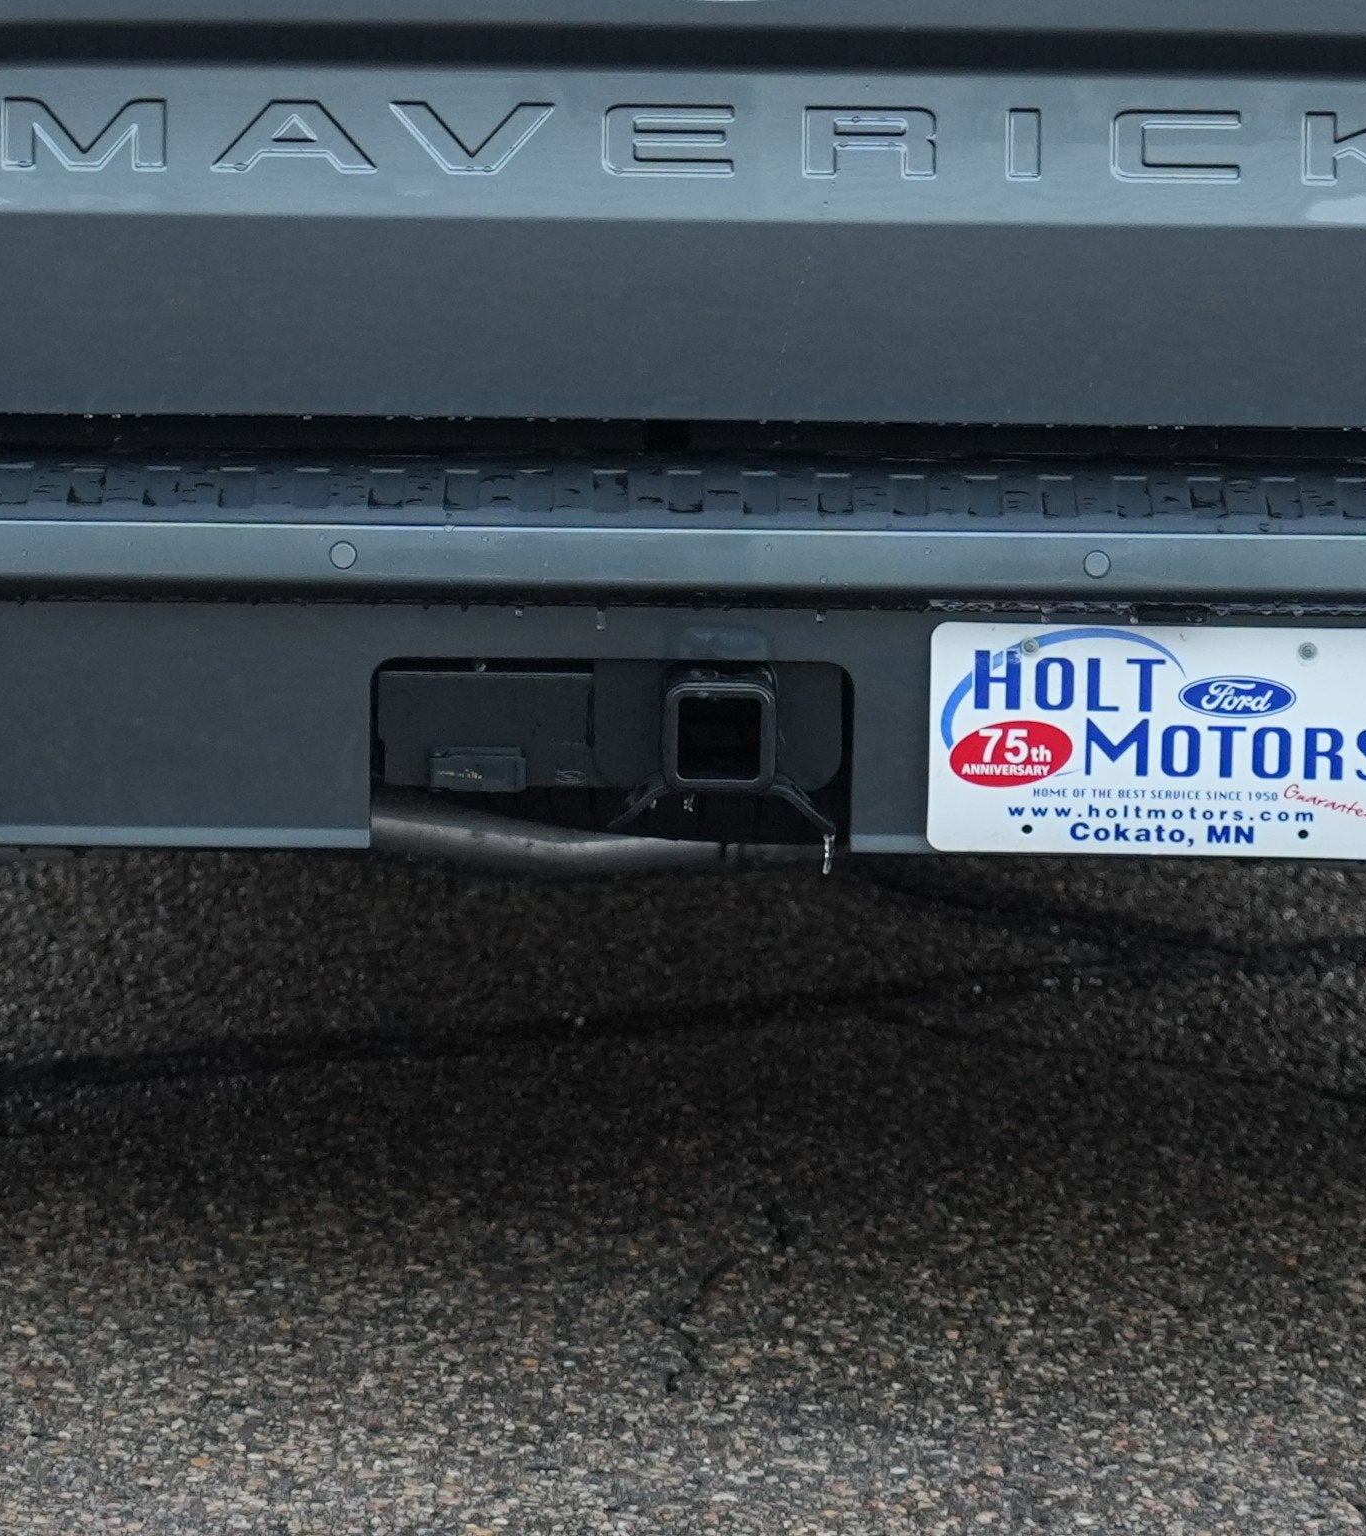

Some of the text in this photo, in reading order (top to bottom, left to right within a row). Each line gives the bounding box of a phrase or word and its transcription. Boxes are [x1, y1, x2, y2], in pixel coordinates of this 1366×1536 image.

[974, 649, 1166, 713] HOLT
[1201, 680, 1272, 713] Ford
[978, 728, 1052, 764] 75th
[961, 763, 1051, 777] ANNIVERSARY
[1033, 788, 1278, 802] HOME OF THE BEST SERVICE SINCE 1950
[1007, 804, 1314, 823] www.holtmotors.com
[1069, 822, 1255, 848] Cokato, MN
